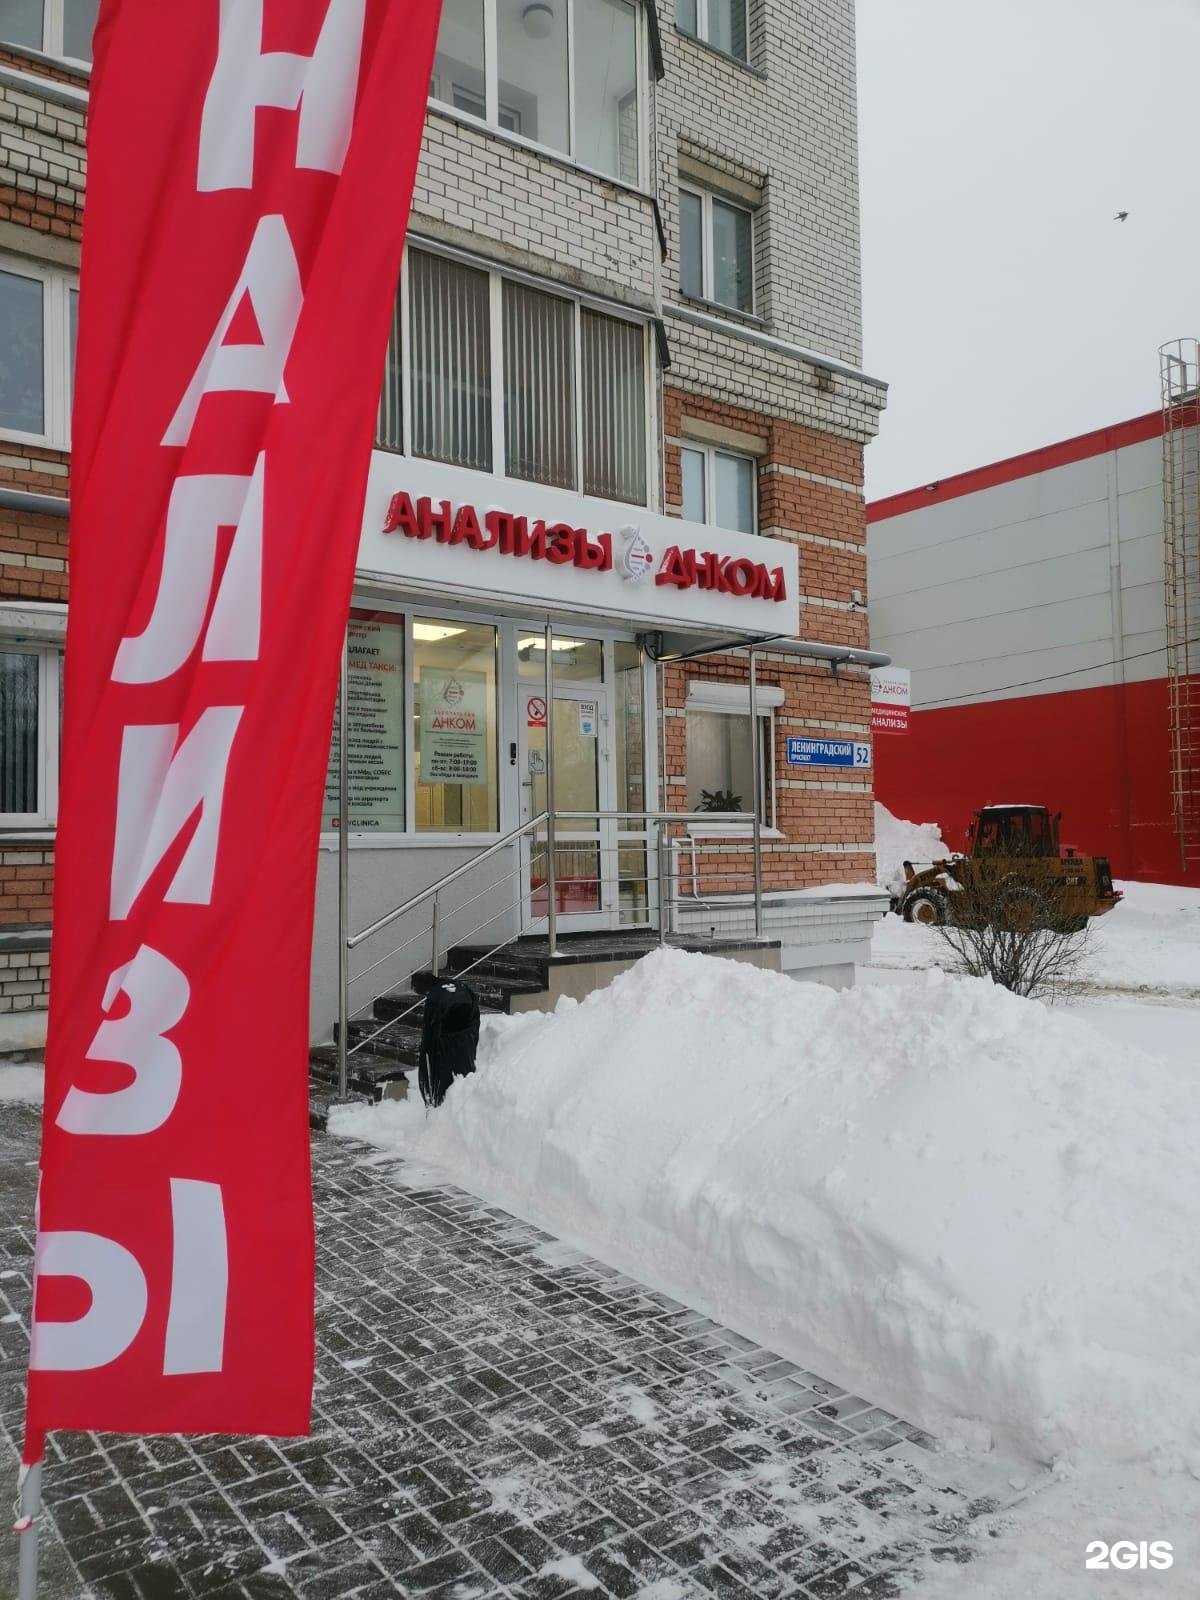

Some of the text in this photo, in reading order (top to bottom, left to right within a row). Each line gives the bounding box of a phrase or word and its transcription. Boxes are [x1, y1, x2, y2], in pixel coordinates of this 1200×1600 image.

[382, 491, 787, 602] АНАЛИЗЫ ДНКОМ
[883, 685, 908, 696] ДНКОМ
[432, 717, 476, 730] ДНКОМ
[871, 717, 908, 729] АНАЛИЗЫ
[791, 741, 852, 757] ЛЕНИНГРАДСКИЙ
[857, 747, 869, 764] 52
